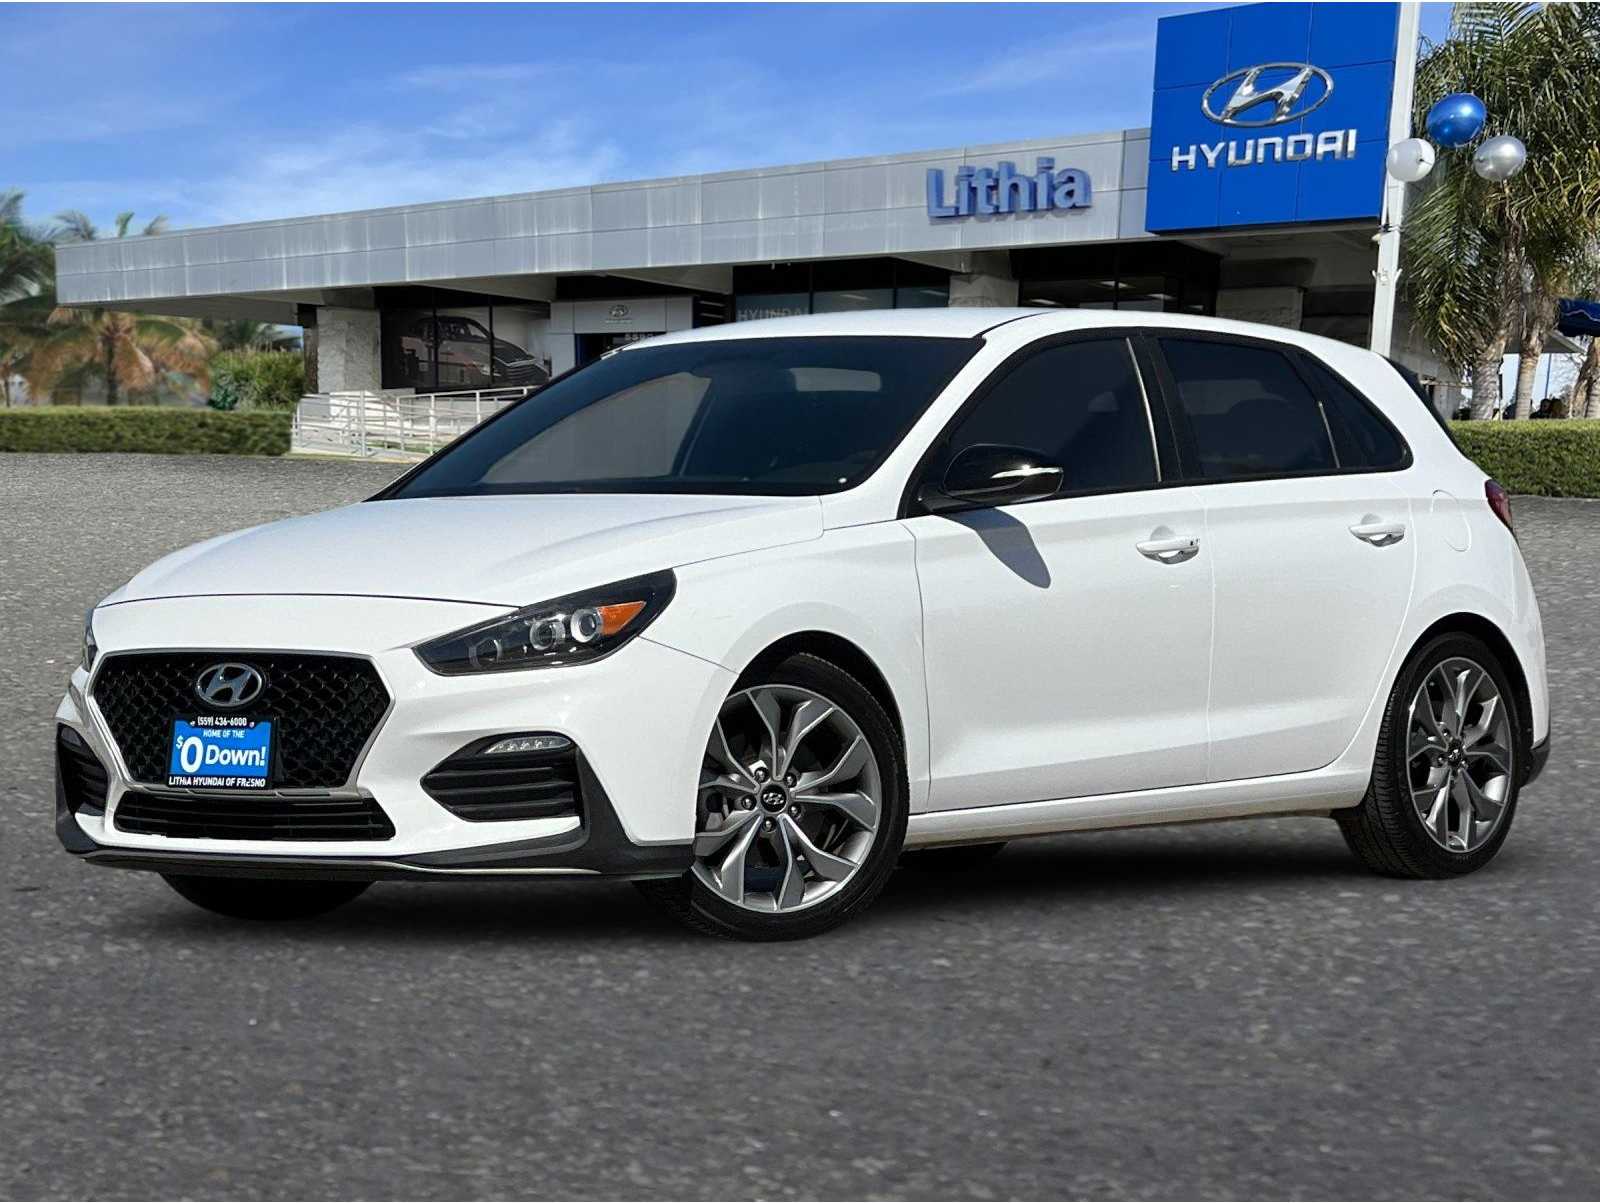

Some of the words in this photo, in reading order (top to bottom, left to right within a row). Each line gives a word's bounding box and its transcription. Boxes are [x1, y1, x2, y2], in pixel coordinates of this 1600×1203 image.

[1171, 128, 1357, 171] HYUNDAI
[926, 156, 1092, 218] Lithia
[203, 729, 220, 738] HOME
[222, 729, 231, 738] OF
[233, 730, 245, 738] THE
[205, 745, 265, 766] Down!
[168, 776, 191, 786] LITHIA
[193, 776, 224, 787] HYUNDAI
[226, 777, 236, 787] OF
